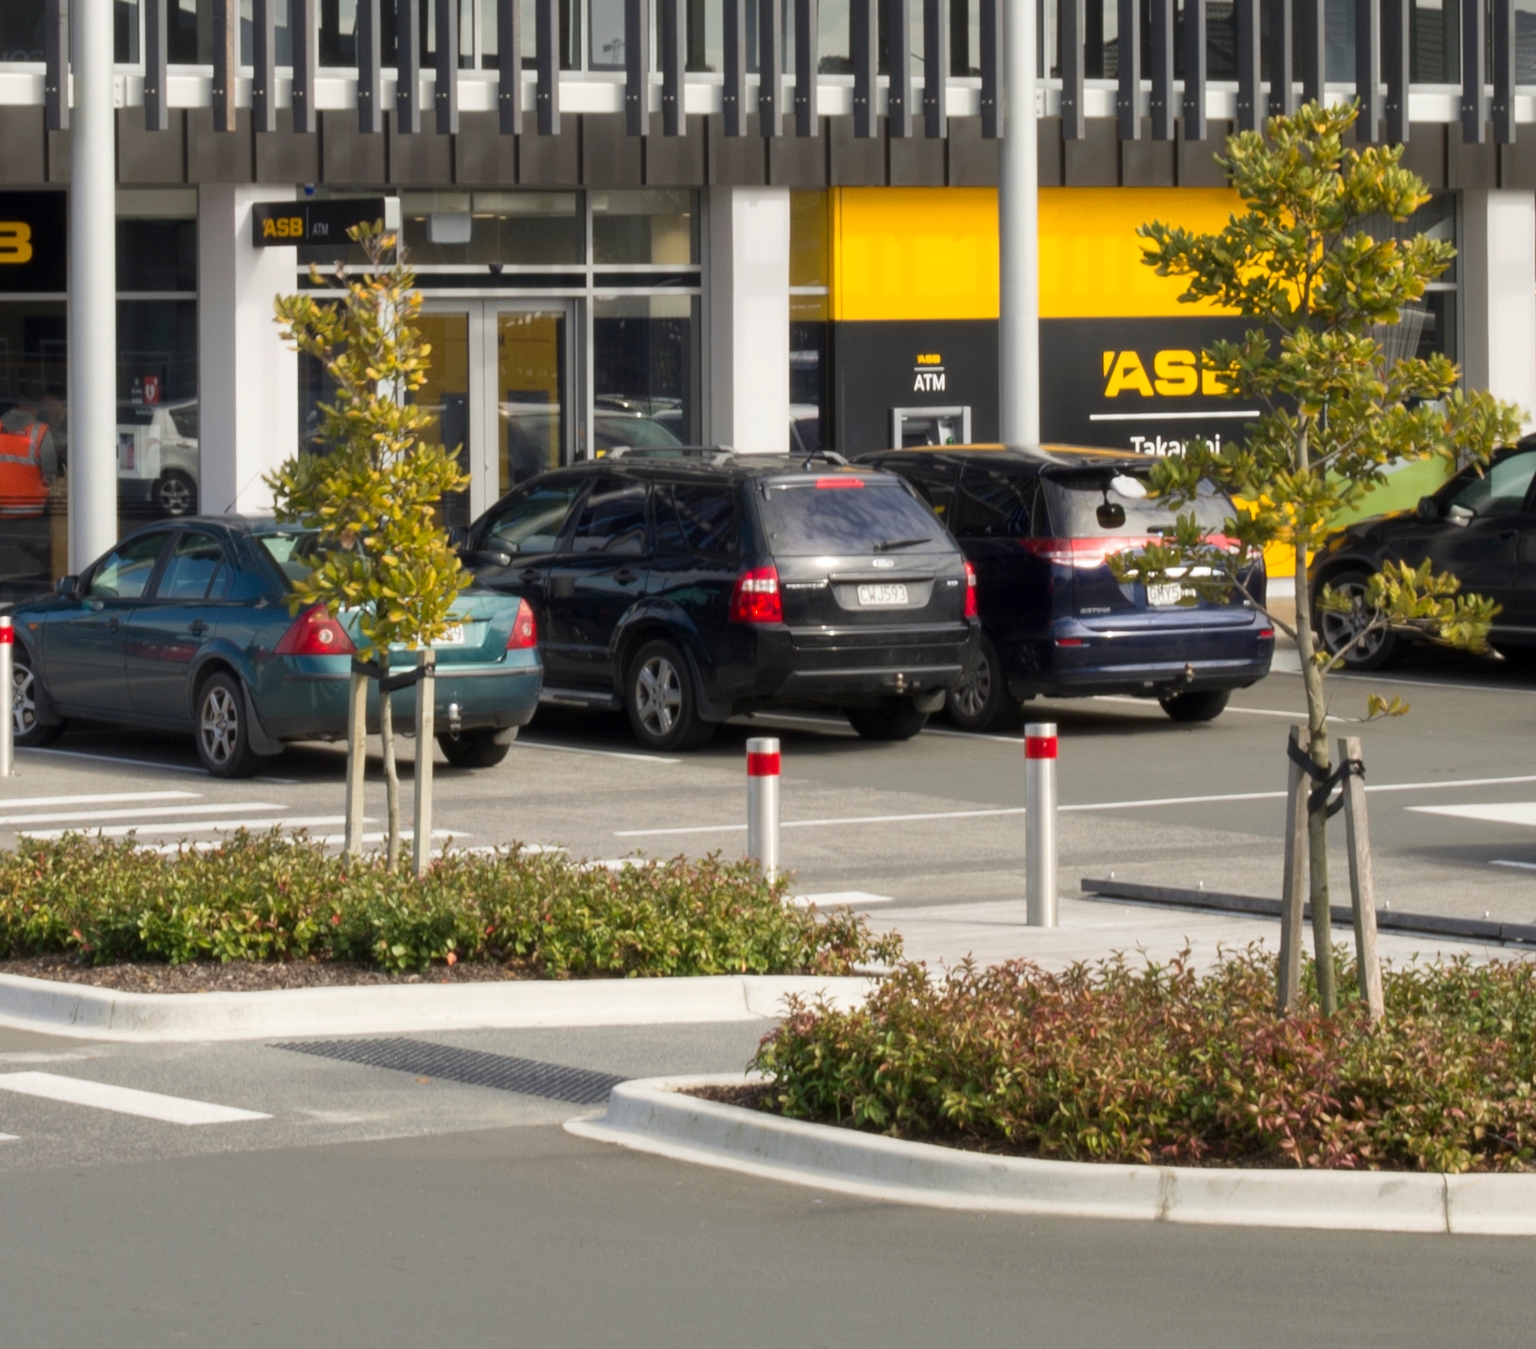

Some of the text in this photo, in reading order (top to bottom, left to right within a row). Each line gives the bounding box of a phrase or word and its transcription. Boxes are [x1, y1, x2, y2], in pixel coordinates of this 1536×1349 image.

[263, 217, 329, 238] ASB ATM
[913, 372, 946, 392] ATM
[861, 586, 908, 602] CWJ593
[1149, 585, 1197, 601] GMY5
